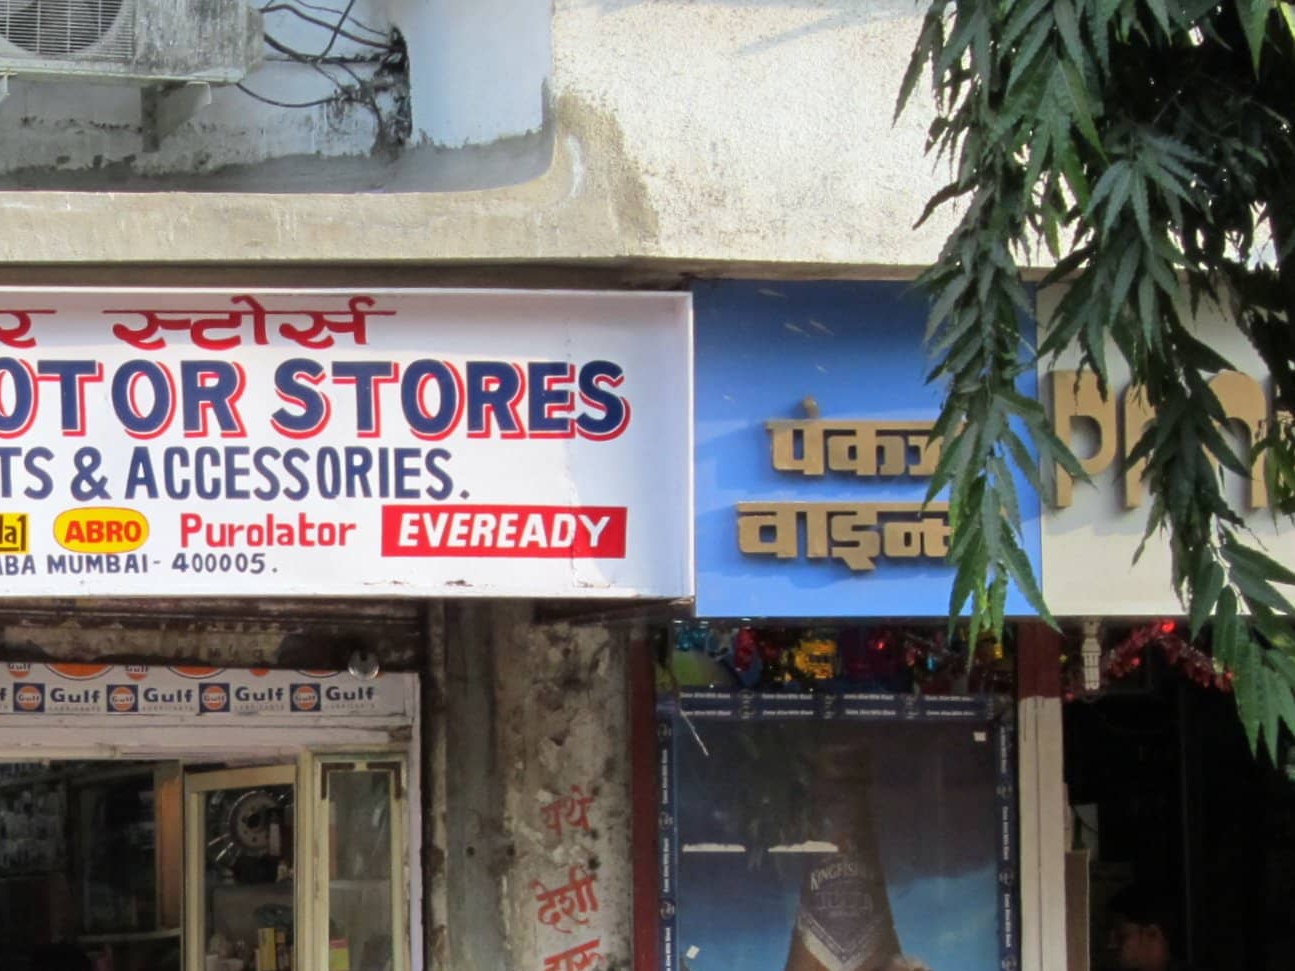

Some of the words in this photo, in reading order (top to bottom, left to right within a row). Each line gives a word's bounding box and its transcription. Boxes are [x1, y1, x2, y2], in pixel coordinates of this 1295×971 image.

[103, 295, 397, 349] स्टोर्स
[269, 357, 631, 441] STORES
[69, 446, 110, 501] &
[124, 446, 471, 501] ACCESSORIES.
[64, 520, 143, 544] ABRO
[180, 512, 357, 548] Purolator
[398, 511, 611, 549] EVEREADY
[50, 688, 101, 703] Gulf
[143, 687, 193, 703] Gulf
[235, 686, 285, 702] Gulf
[325, 686, 375, 701] Gulf
